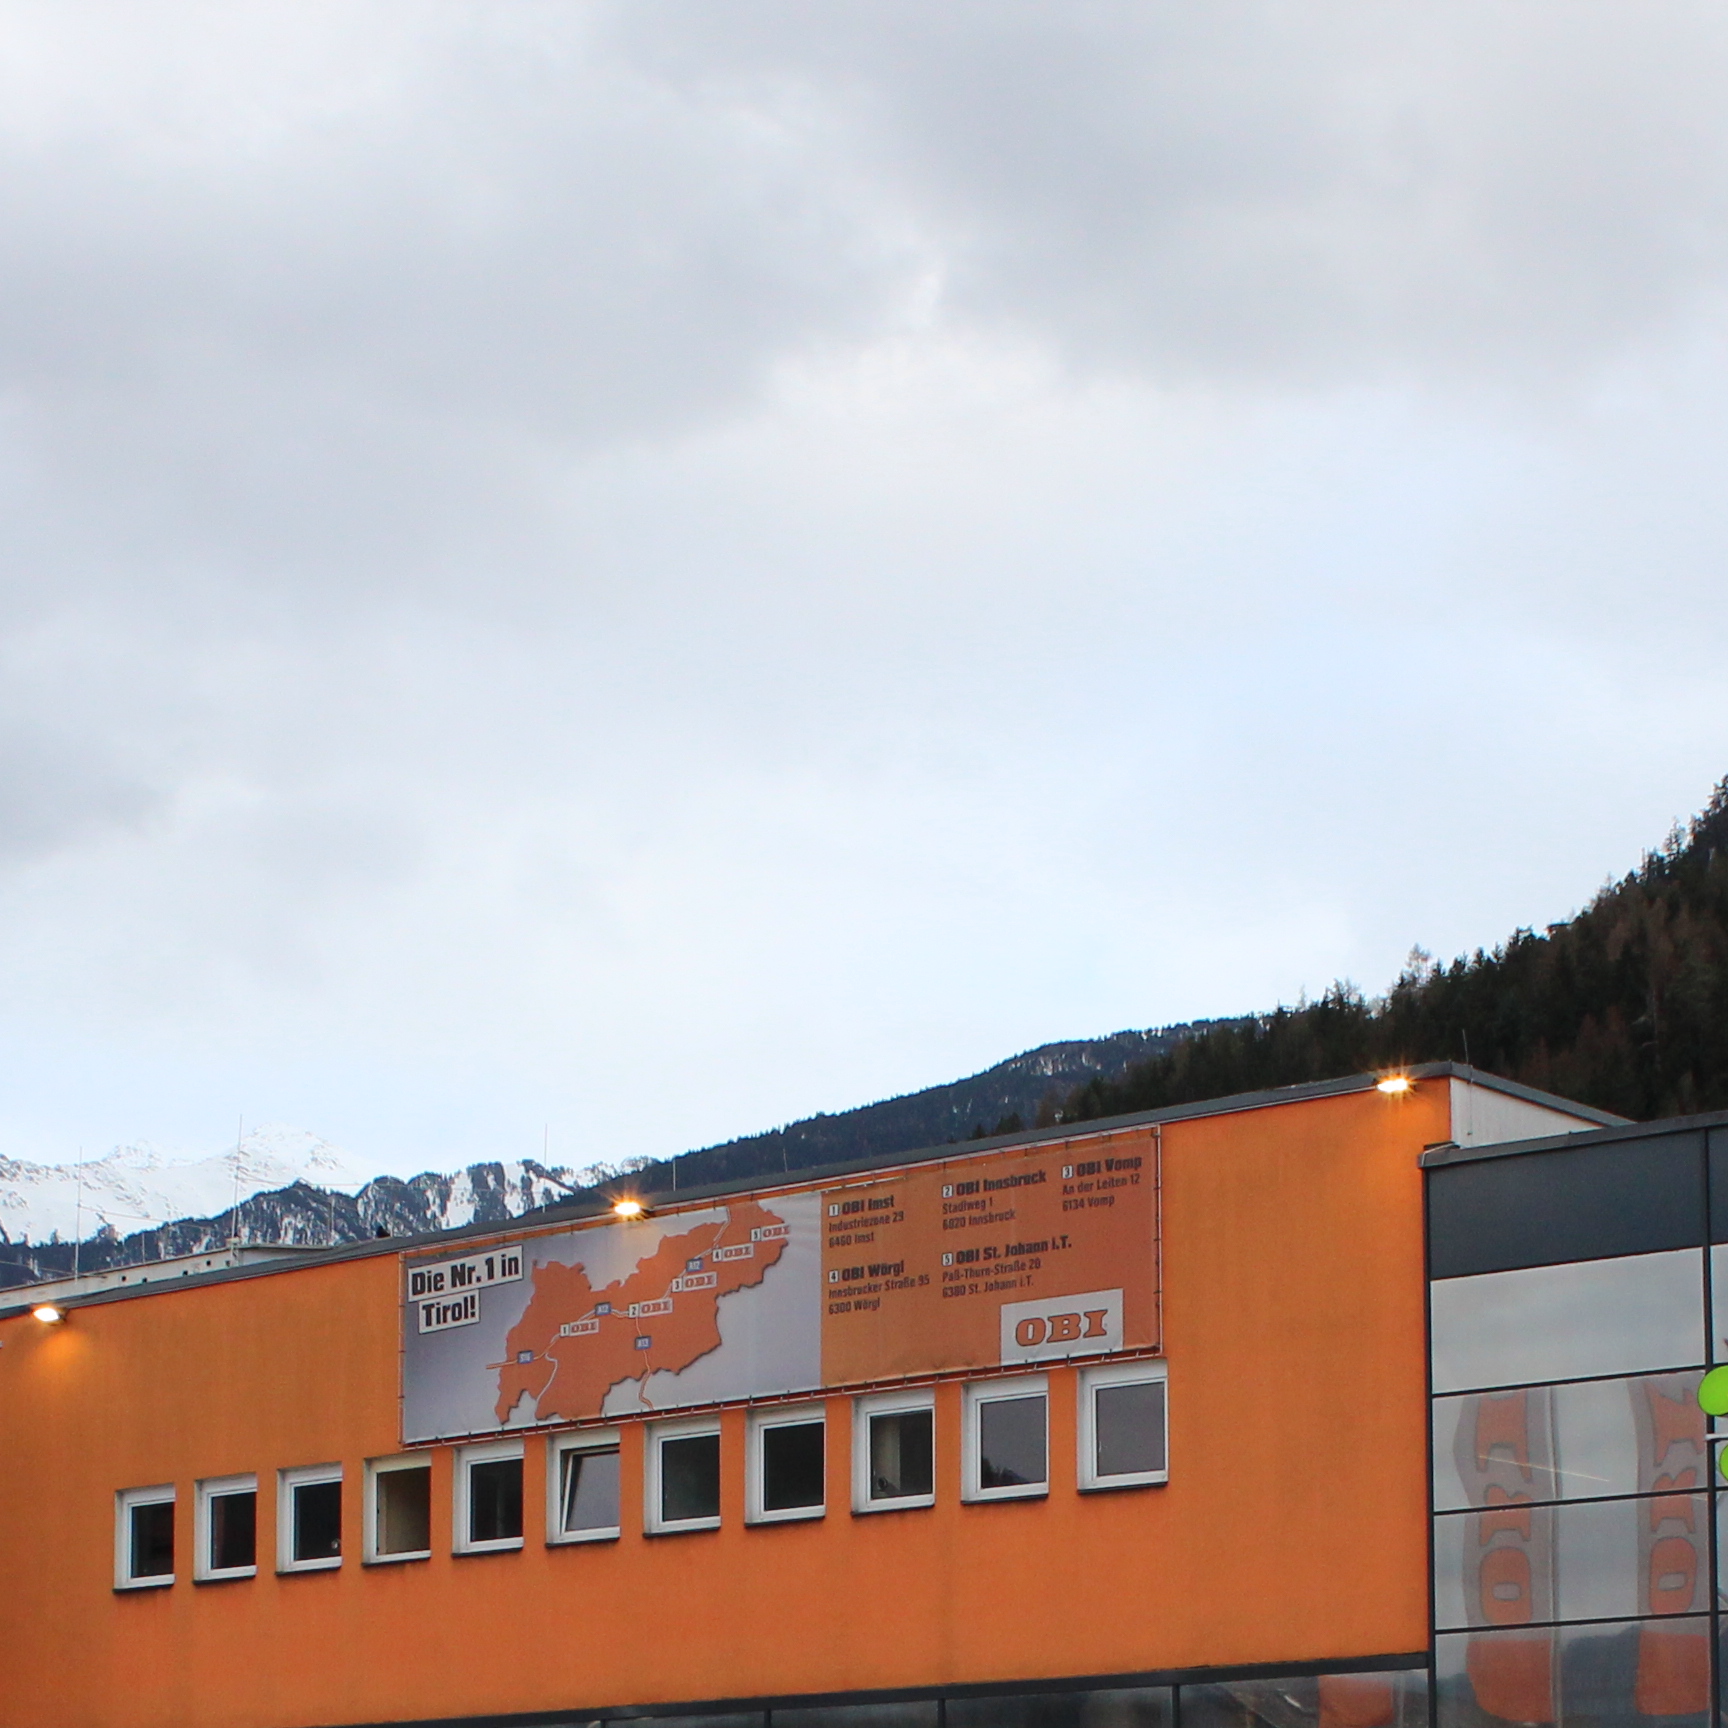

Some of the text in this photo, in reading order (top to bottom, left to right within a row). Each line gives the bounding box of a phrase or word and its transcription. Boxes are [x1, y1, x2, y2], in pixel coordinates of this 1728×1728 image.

[1076, 1161, 1101, 1176] OBI
[1105, 1156, 1142, 1173] Vomp
[956, 1181, 980, 1196] OBI
[983, 1170, 1047, 1192] Innsbruck
[1062, 1184, 1075, 1195] An
[1077, 1181, 1093, 1193] der
[1130, 1173, 1141, 1185] 12
[842, 1199, 865, 1214] OBI
[868, 1195, 895, 1211] Imst
[1088, 1194, 1115, 1208] Vomp
[828, 1214, 890, 1233] Industriezone
[968, 1209, 1016, 1226] Innsbruck
[763, 1226, 790, 1239] OBI
[854, 1232, 874, 1244] Imst
[724, 1246, 752, 1258] OBI
[956, 1248, 980, 1264] OBI
[983, 1245, 1000, 1261] St.
[1005, 1239, 1048, 1257] Johann
[412, 1254, 519, 1296] Die Nr. 1 in
[842, 1266, 865, 1281] OBI
[868, 1260, 905, 1278] Wörgl
[685, 1275, 714, 1288] OBI
[828, 1282, 882, 1299] Innsbrucker
[885, 1276, 916, 1291] Straße
[984, 1277, 1017, 1293] Johann
[422, 1295, 476, 1327] Tirol!
[641, 1300, 671, 1314] OBI
[854, 1298, 880, 1312] Wörgl
[571, 1322, 597, 1333] OBI
[1015, 1309, 1108, 1347] OBI
